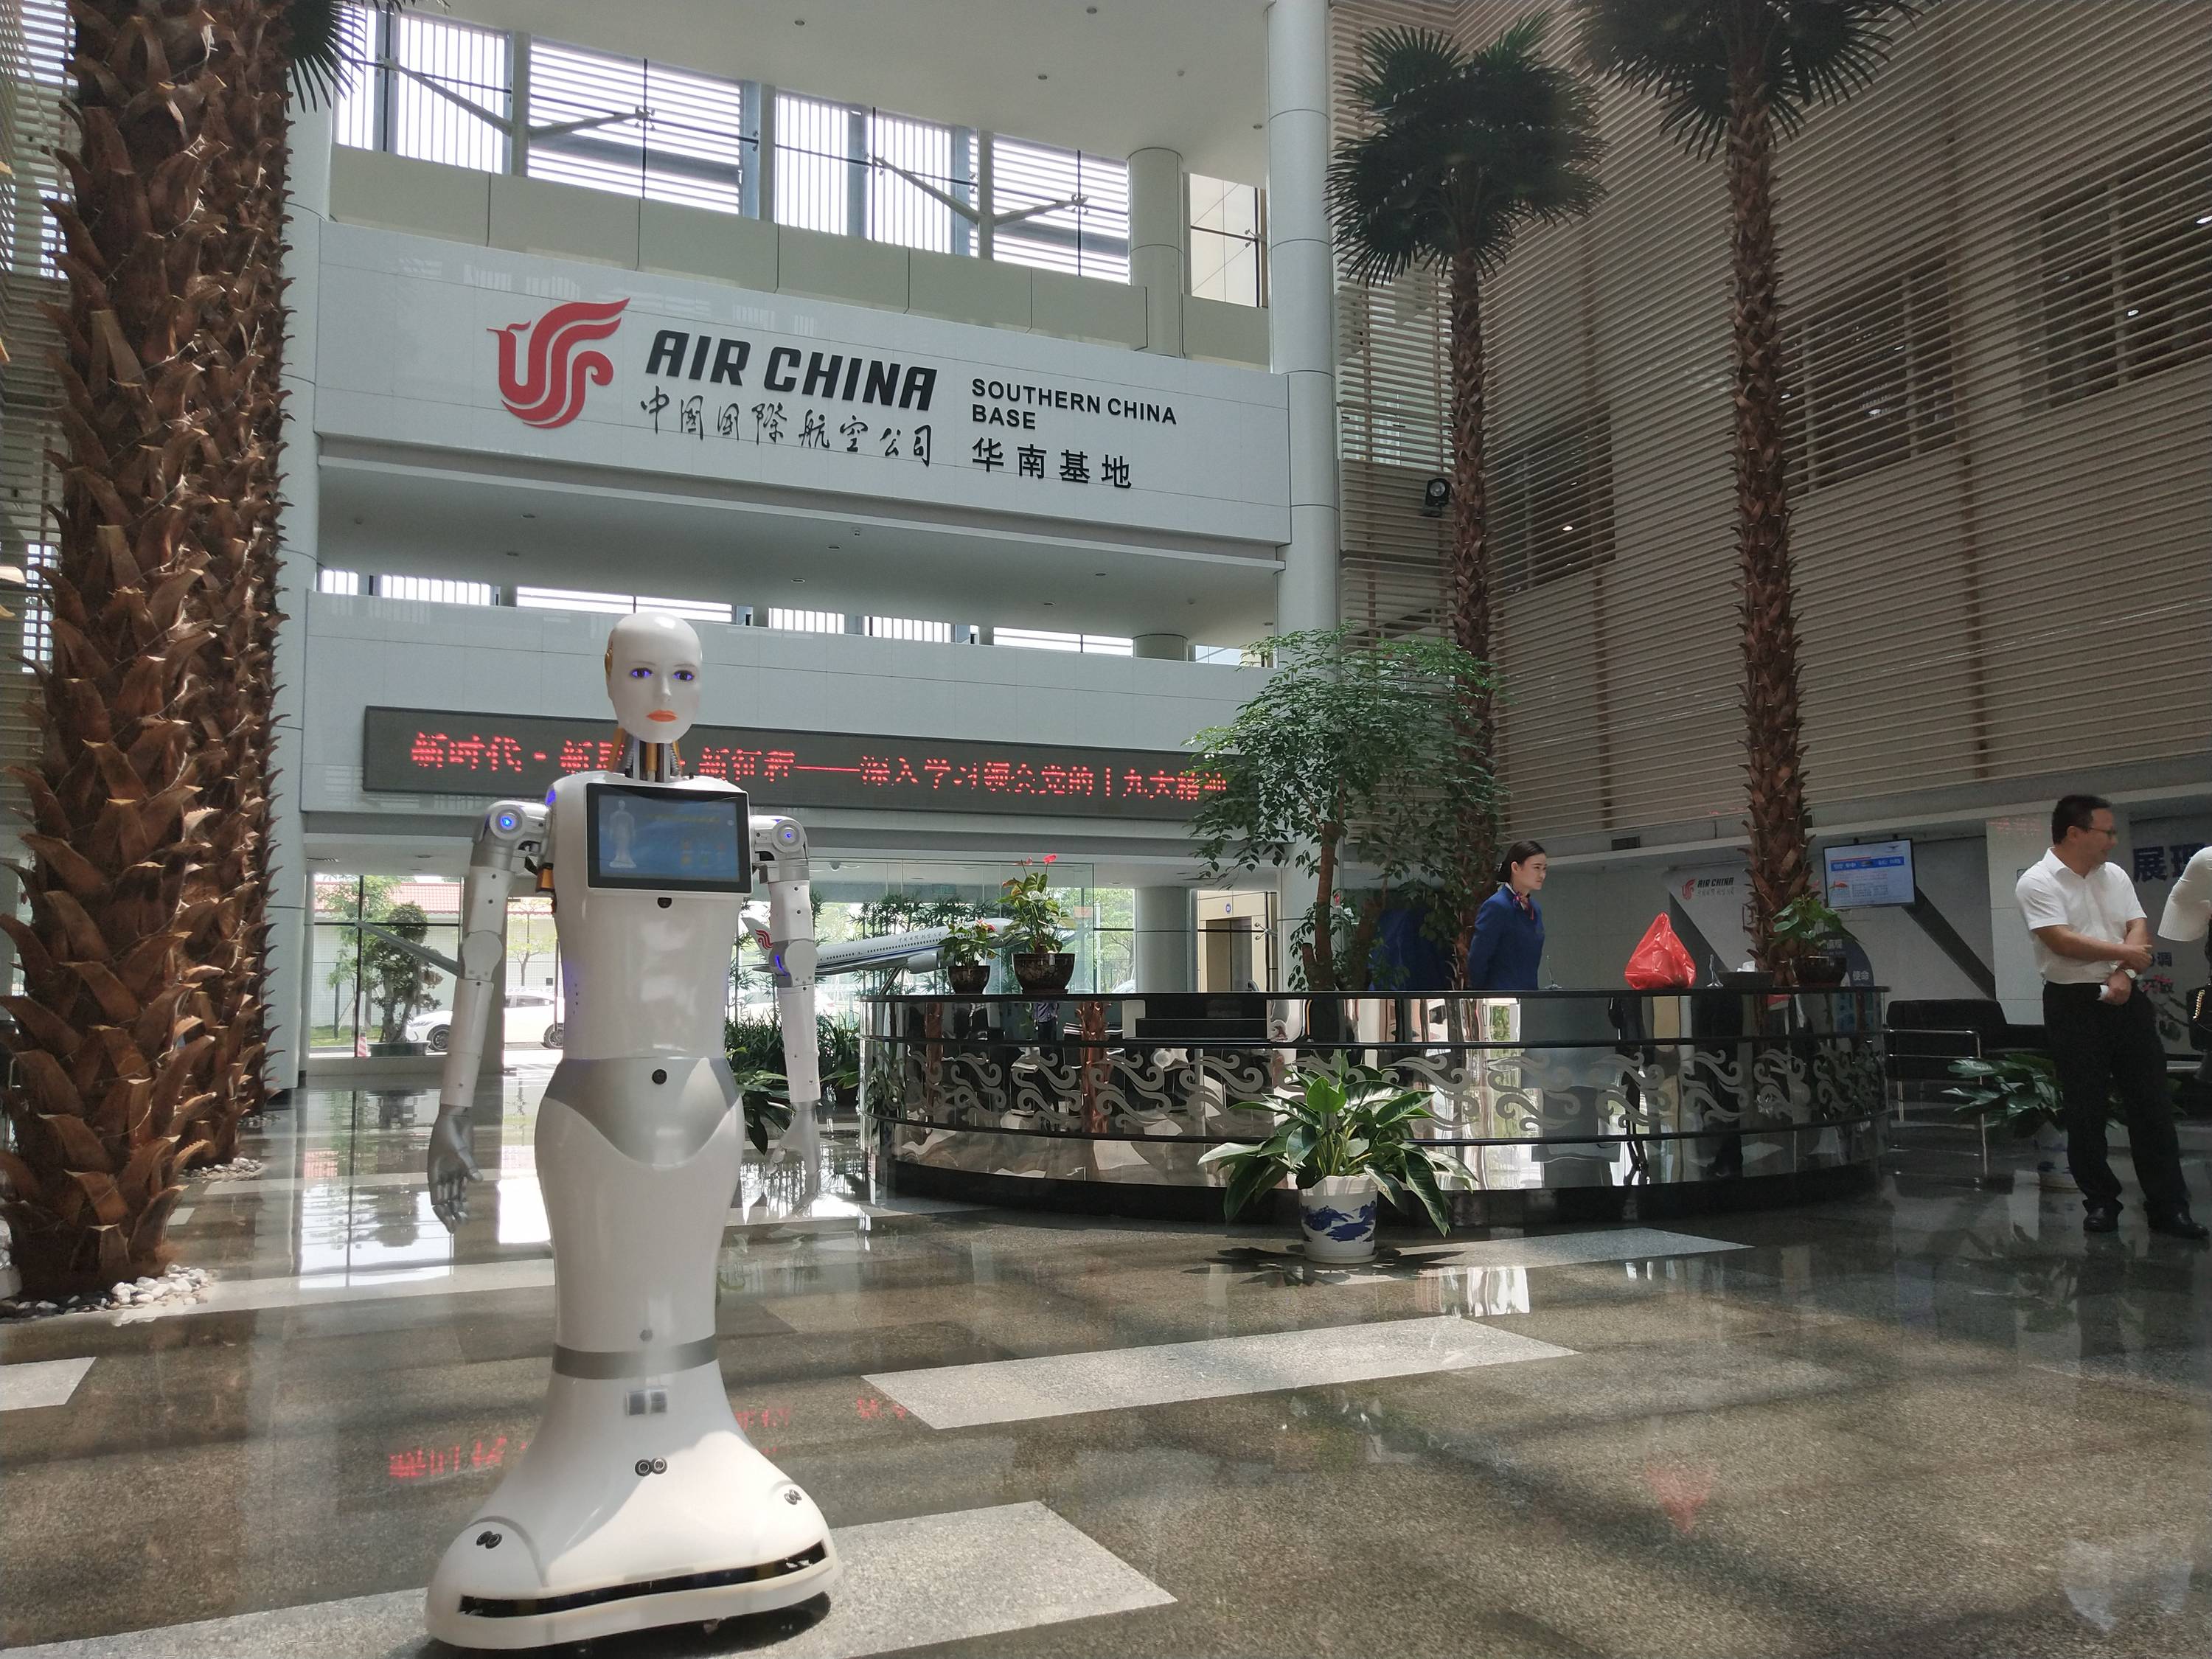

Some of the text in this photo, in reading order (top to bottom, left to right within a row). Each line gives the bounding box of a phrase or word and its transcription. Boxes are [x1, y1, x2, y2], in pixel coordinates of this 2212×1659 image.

[645, 329, 938, 411] AIR CHINA
[971, 378, 1178, 425] SOUTHERN CHINA
[971, 403, 1036, 430] BASE
[971, 437, 1133, 490] 华南基地
[1697, 877, 1735, 888] AIR CHINA
